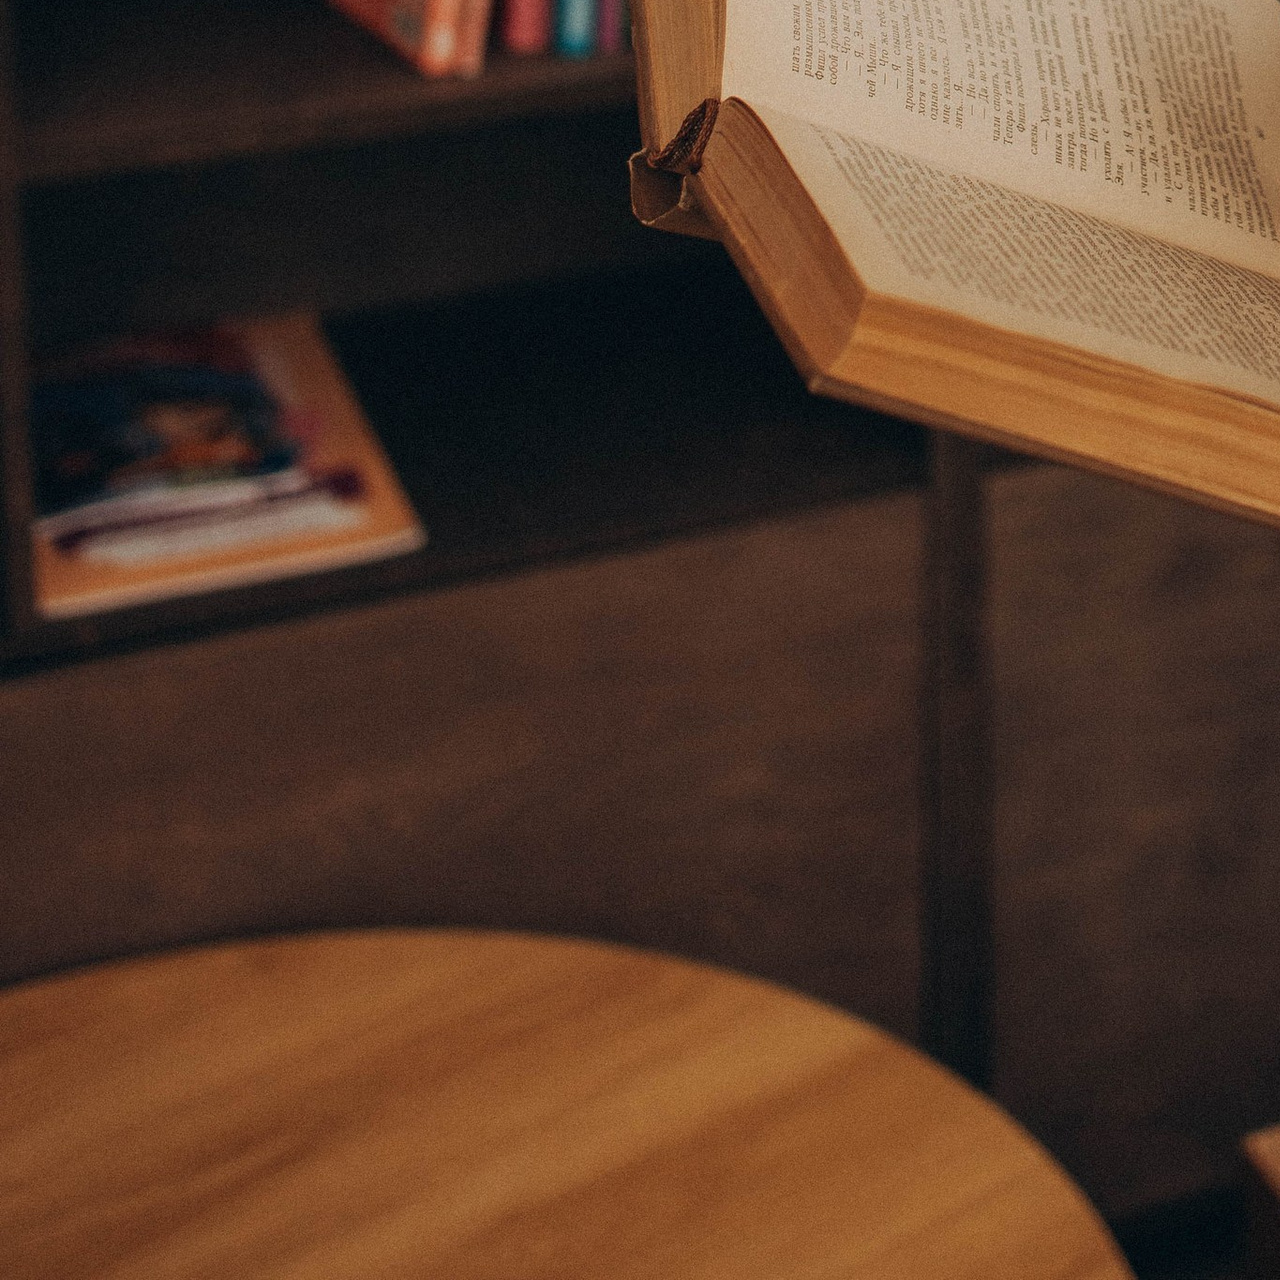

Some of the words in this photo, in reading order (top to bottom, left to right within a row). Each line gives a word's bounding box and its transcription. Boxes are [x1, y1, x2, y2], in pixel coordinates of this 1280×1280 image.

[792, 2, 800, 42] свежим
[841, 13, 851, 33] вам
[875, 7, 886, 29] тебе
[817, 15, 828, 46] успел
[879, 30, 888, 46] же
[890, 18, 901, 57] слышал
[915, 25, 923, 38] не
[840, 34, 851, 56] Что
[963, 41, 972, 54] ты
[790, 43, 800, 73] шать
[878, 47, 889, 68] Что
[916, 40, 926, 74] ничего
[966, 57, 976, 80] ведь
[976, 48, 986, 68] мне
[1001, 58, 1012, 78] рад,
[827, 52, 838, 86] собой
[979, 68, 987, 83] но
[865, 77, 876, 99] чей
[905, 54, 916, 113] дрожащим
[965, 81, 976, 99] Но
[978, 86, 990, 104] Да,
[1003, 78, 1012, 96] так
[917, 89, 926, 116] хотя
[929, 81, 940, 122] однако
[1039, 86, 1051, 125] Хорошо,
[1051, 89, 1061, 112] могу
[1063, 96, 1074, 125] после
[941, 102, 950, 125] мне
[1054, 115, 1062, 129] не
[992, 114, 1000, 143] чали
[1002, 107, 1015, 147] Теперь
[1088, 126, 1099, 143] Но
[1030, 122, 1038, 156] слезы.
[1067, 131, 1077, 170] завтра,
[1079, 141, 1089, 173] тогда
[1102, 138, 1114, 183] уходить
[1114, 162, 1124, 187] Эля.
